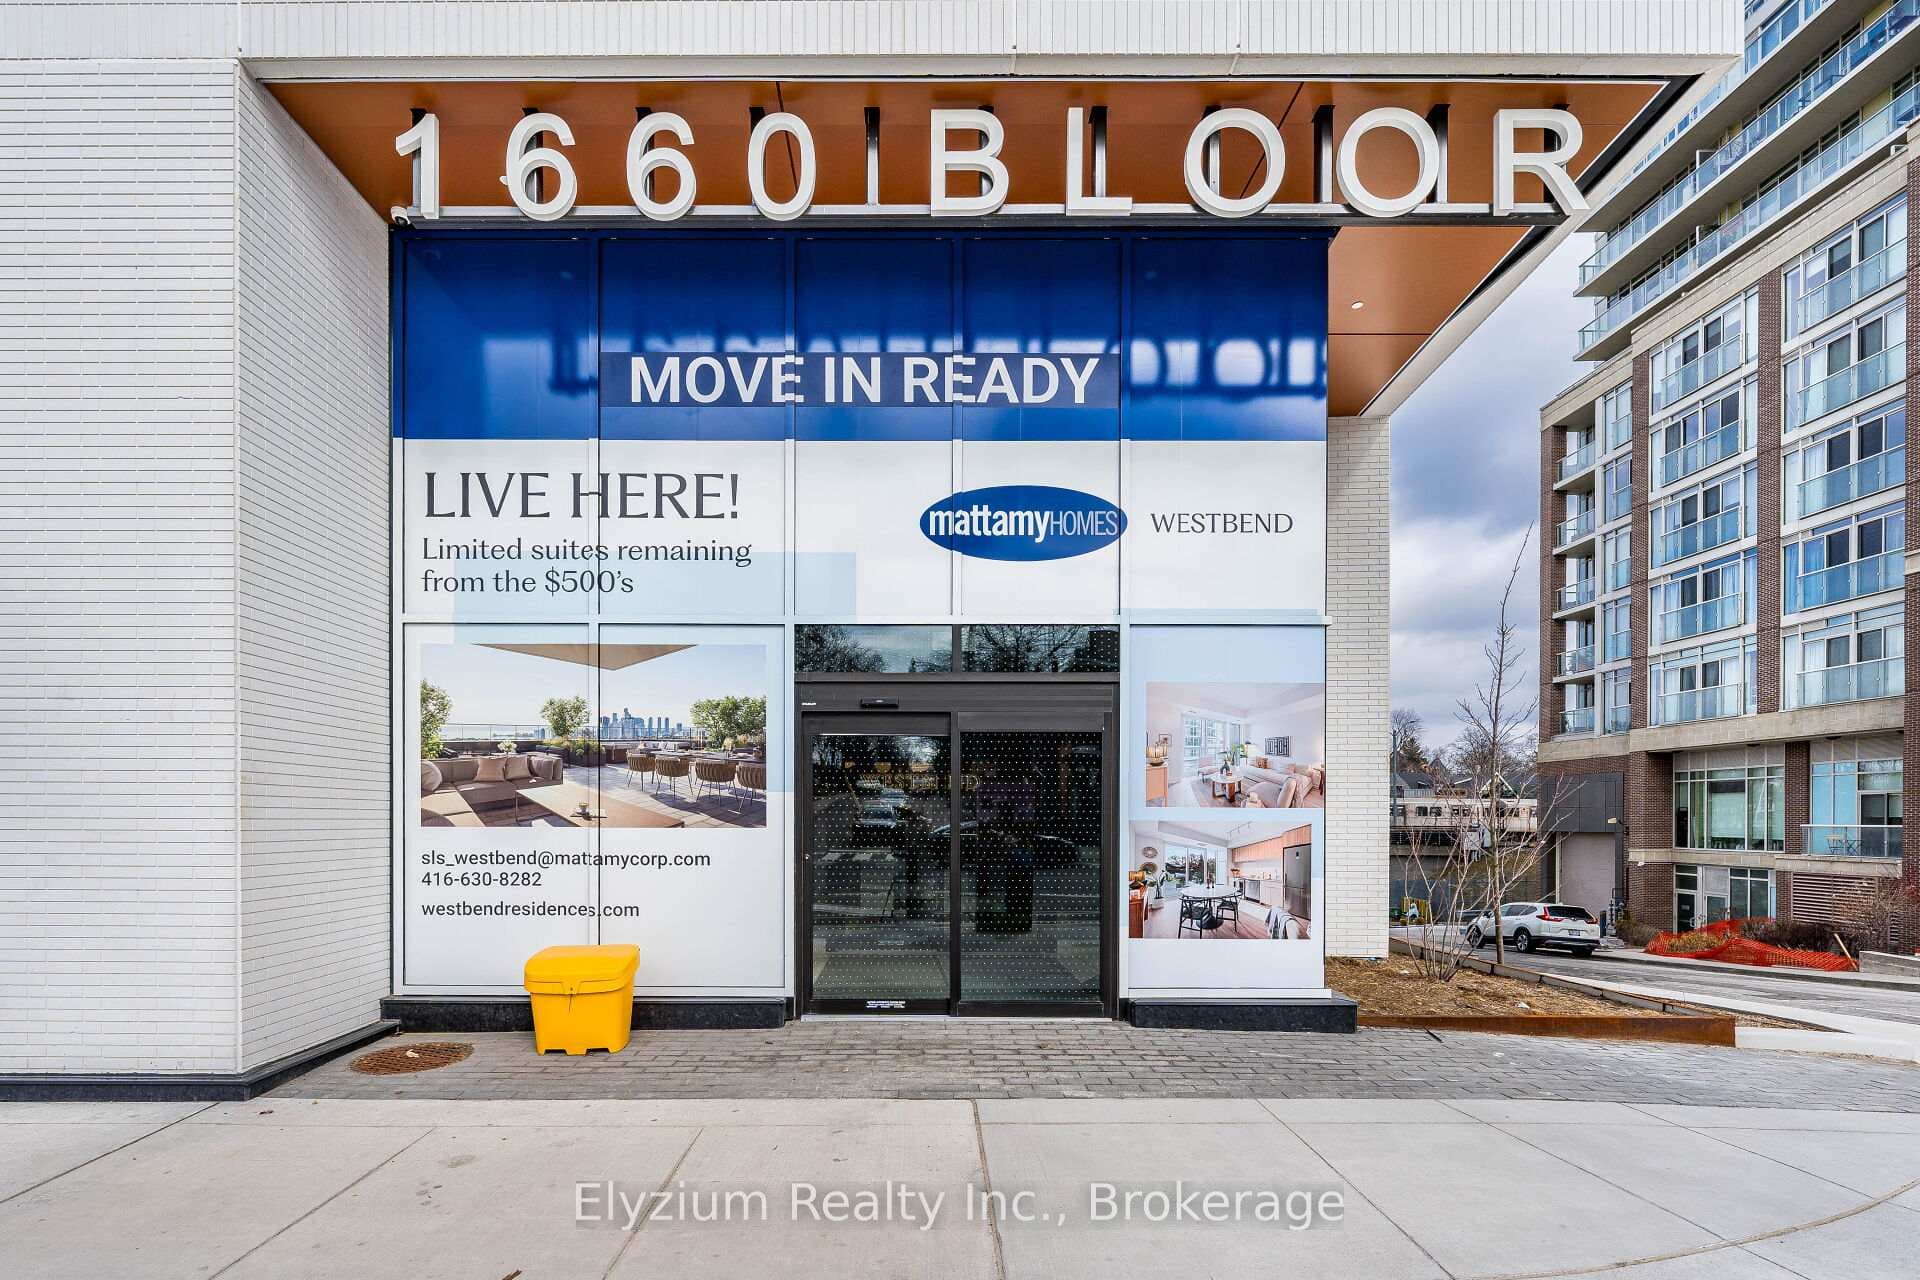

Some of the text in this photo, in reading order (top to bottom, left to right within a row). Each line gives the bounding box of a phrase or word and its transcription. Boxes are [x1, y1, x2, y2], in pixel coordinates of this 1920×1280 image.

[395, 107, 1592, 222] 1660 BLOOR
[630, 354, 1100, 405] MOVE IN READY
[425, 472, 740, 520] LIVE HERE!
[1150, 512, 1294, 534] WESTBEND
[422, 537, 752, 568] Limited suites remaining
[421, 566, 635, 597] from the $500's
[421, 850, 711, 869] sls_westbend@mattamycorp.com
[421, 871, 542, 887] 416-630-8282
[421, 901, 640, 917] westbendresidences.com
